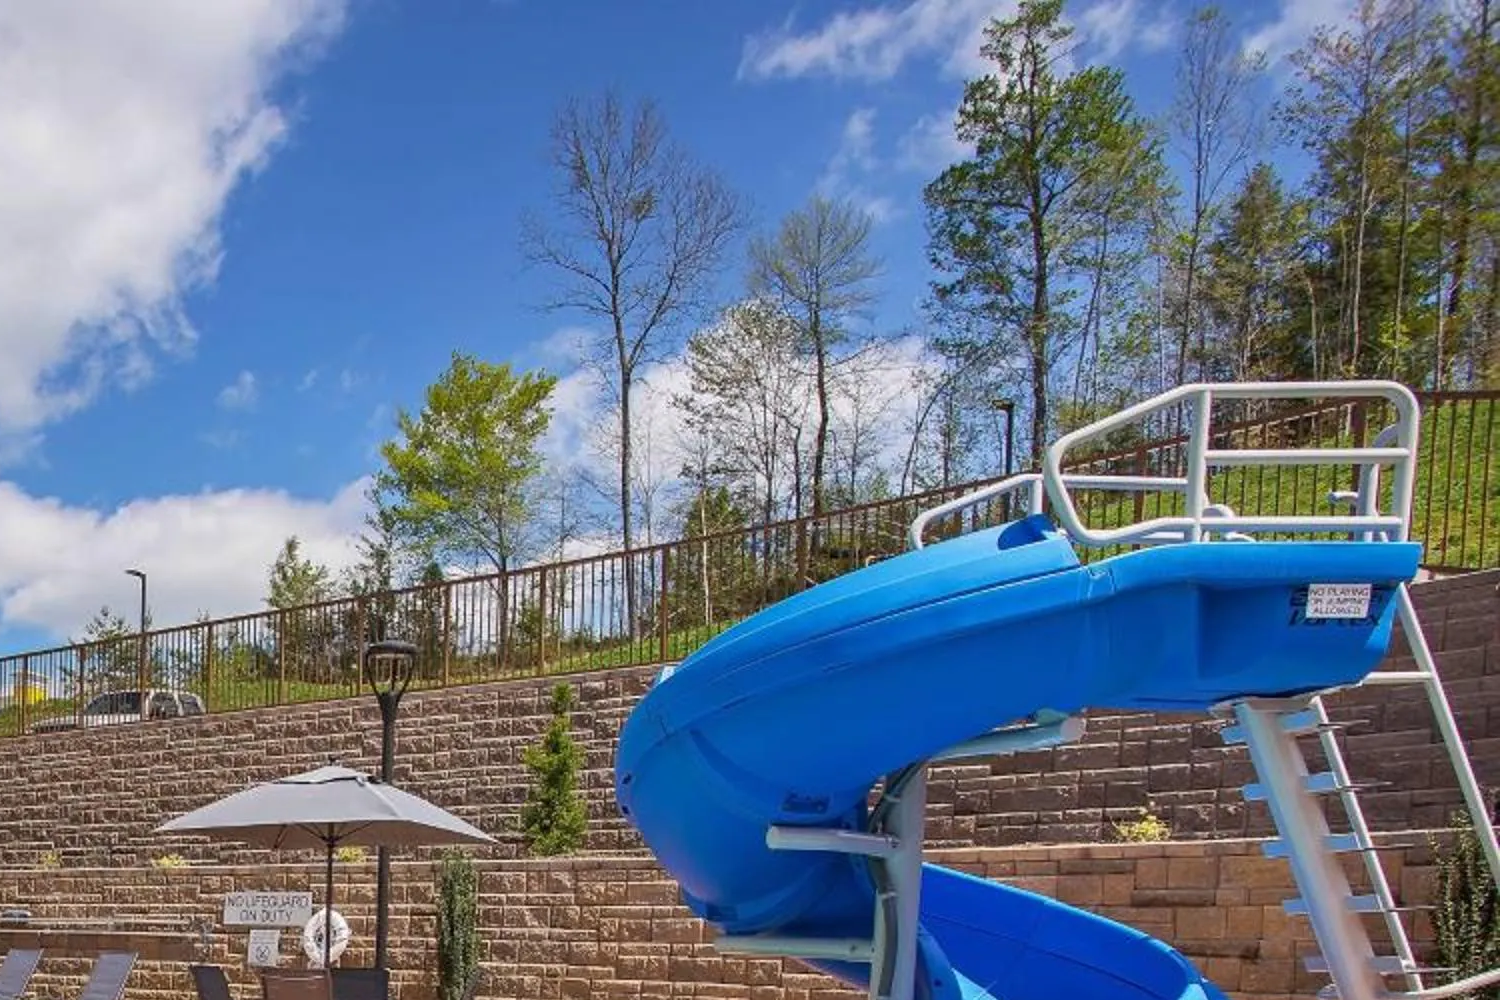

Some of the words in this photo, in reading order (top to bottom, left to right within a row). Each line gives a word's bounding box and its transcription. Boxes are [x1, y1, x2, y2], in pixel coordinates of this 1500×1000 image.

[1310, 587, 1325, 596] NO
[1328, 587, 1369, 596] PLAYING
[1313, 606, 1361, 615] ALLOWED
[227, 895, 244, 907] NO
[246, 895, 310, 908] LIFEGUARD
[240, 909, 257, 921] ON
[261, 909, 293, 922] DUTY
